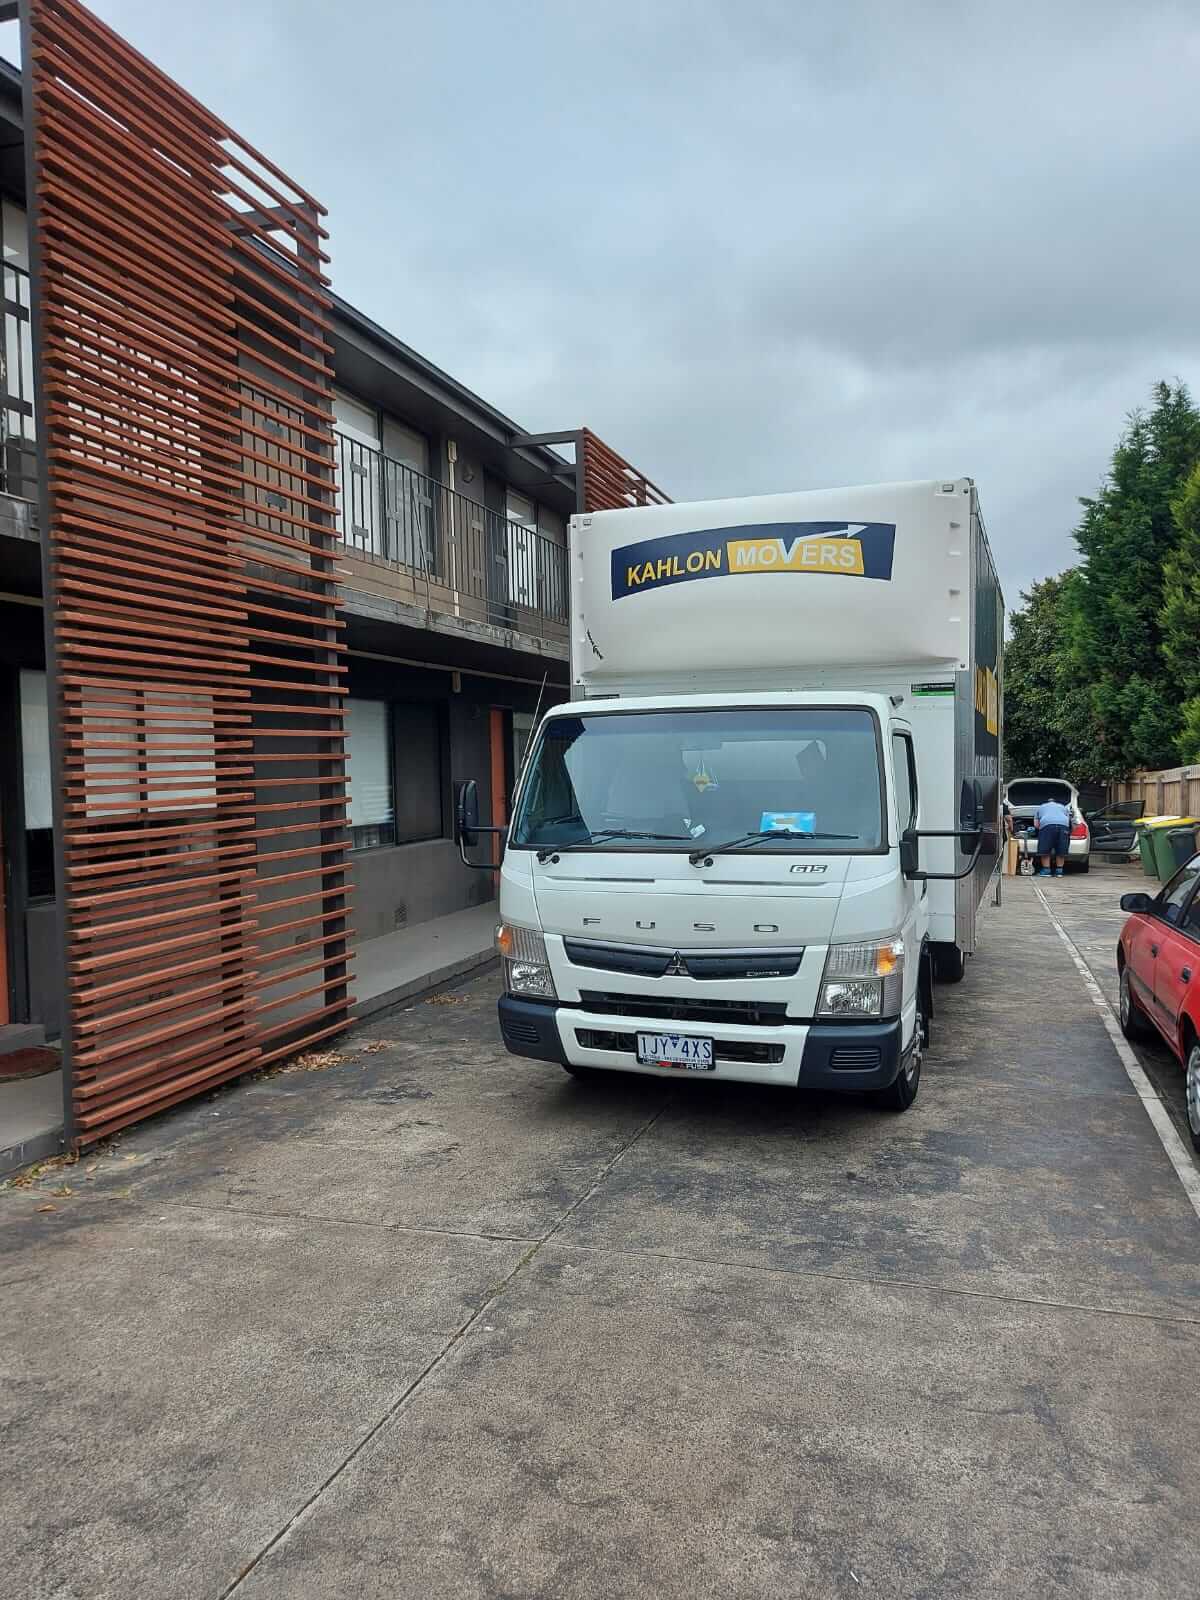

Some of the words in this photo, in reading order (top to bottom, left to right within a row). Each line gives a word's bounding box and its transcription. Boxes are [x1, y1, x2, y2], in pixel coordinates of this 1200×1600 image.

[626, 548, 722, 588] KAHLON
[735, 536, 857, 568] MOVERS
[583, 917, 779, 933] FUSO
